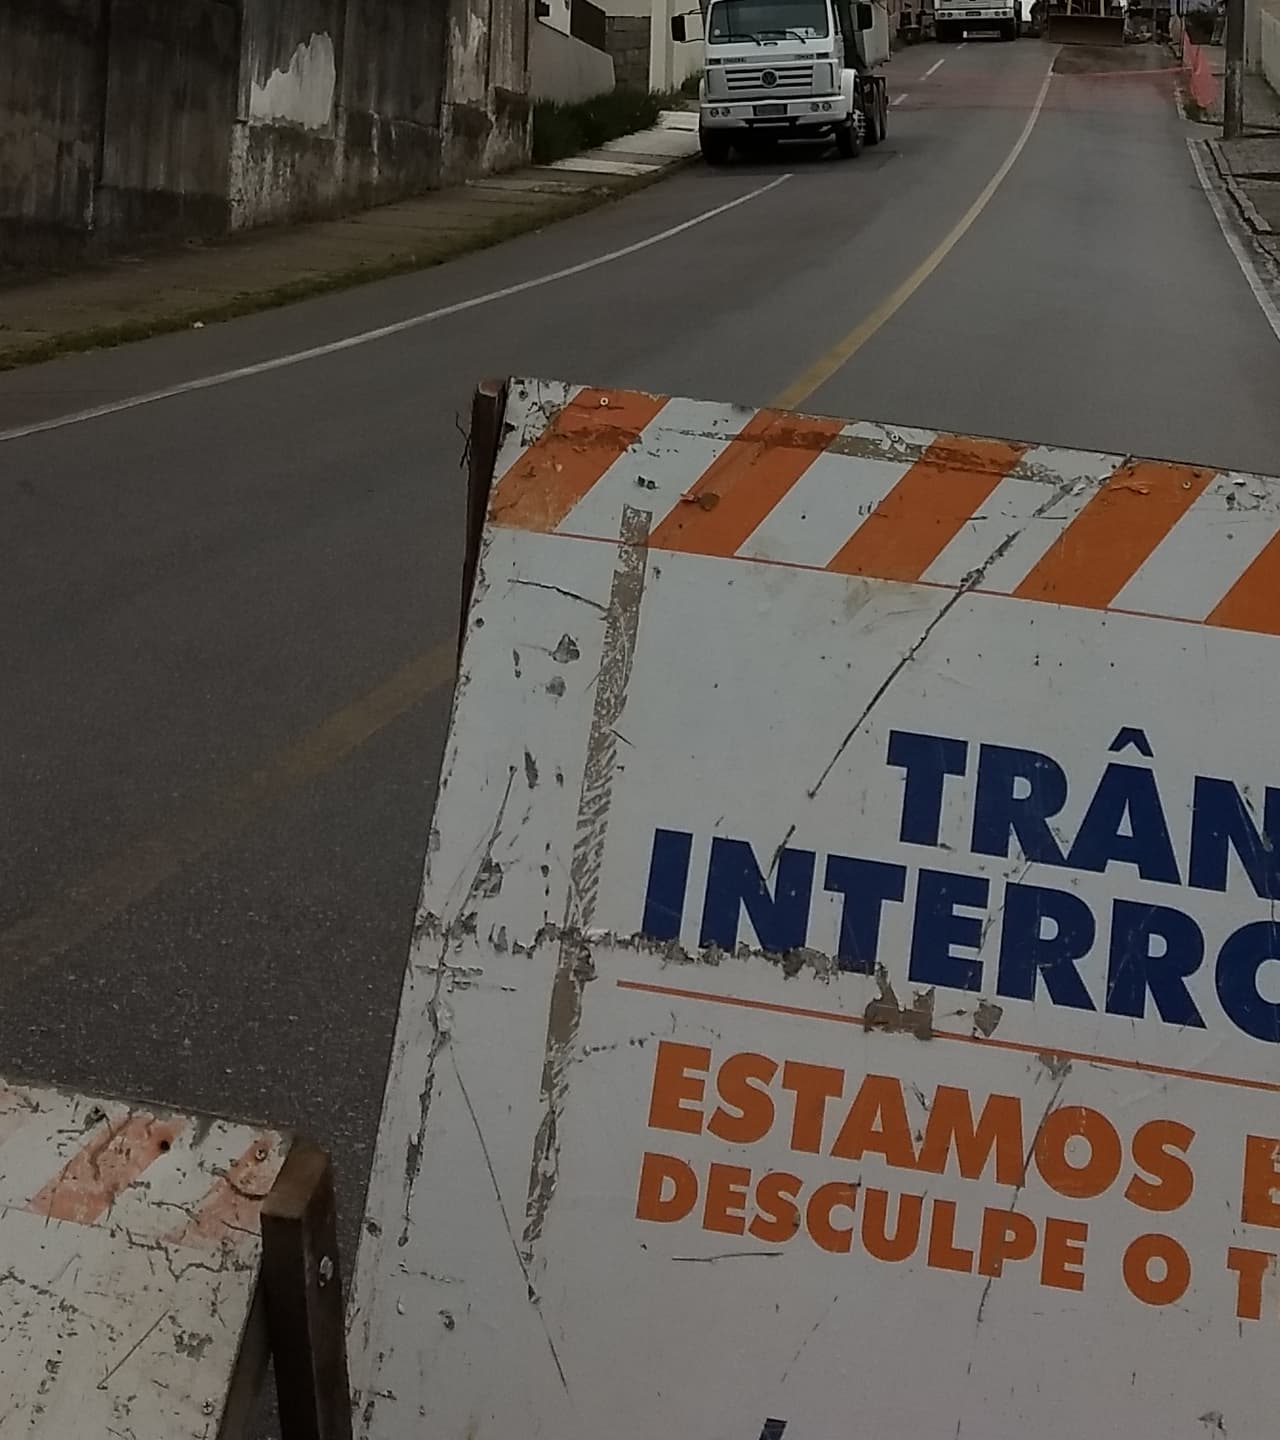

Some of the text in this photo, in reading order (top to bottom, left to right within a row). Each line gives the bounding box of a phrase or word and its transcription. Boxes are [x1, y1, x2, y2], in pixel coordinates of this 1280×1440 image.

[647, 1040, 1196, 1213] ESTAMOS
[635, 1152, 1090, 1292] DESCULPE
[1122, 1233, 1192, 1306] O
